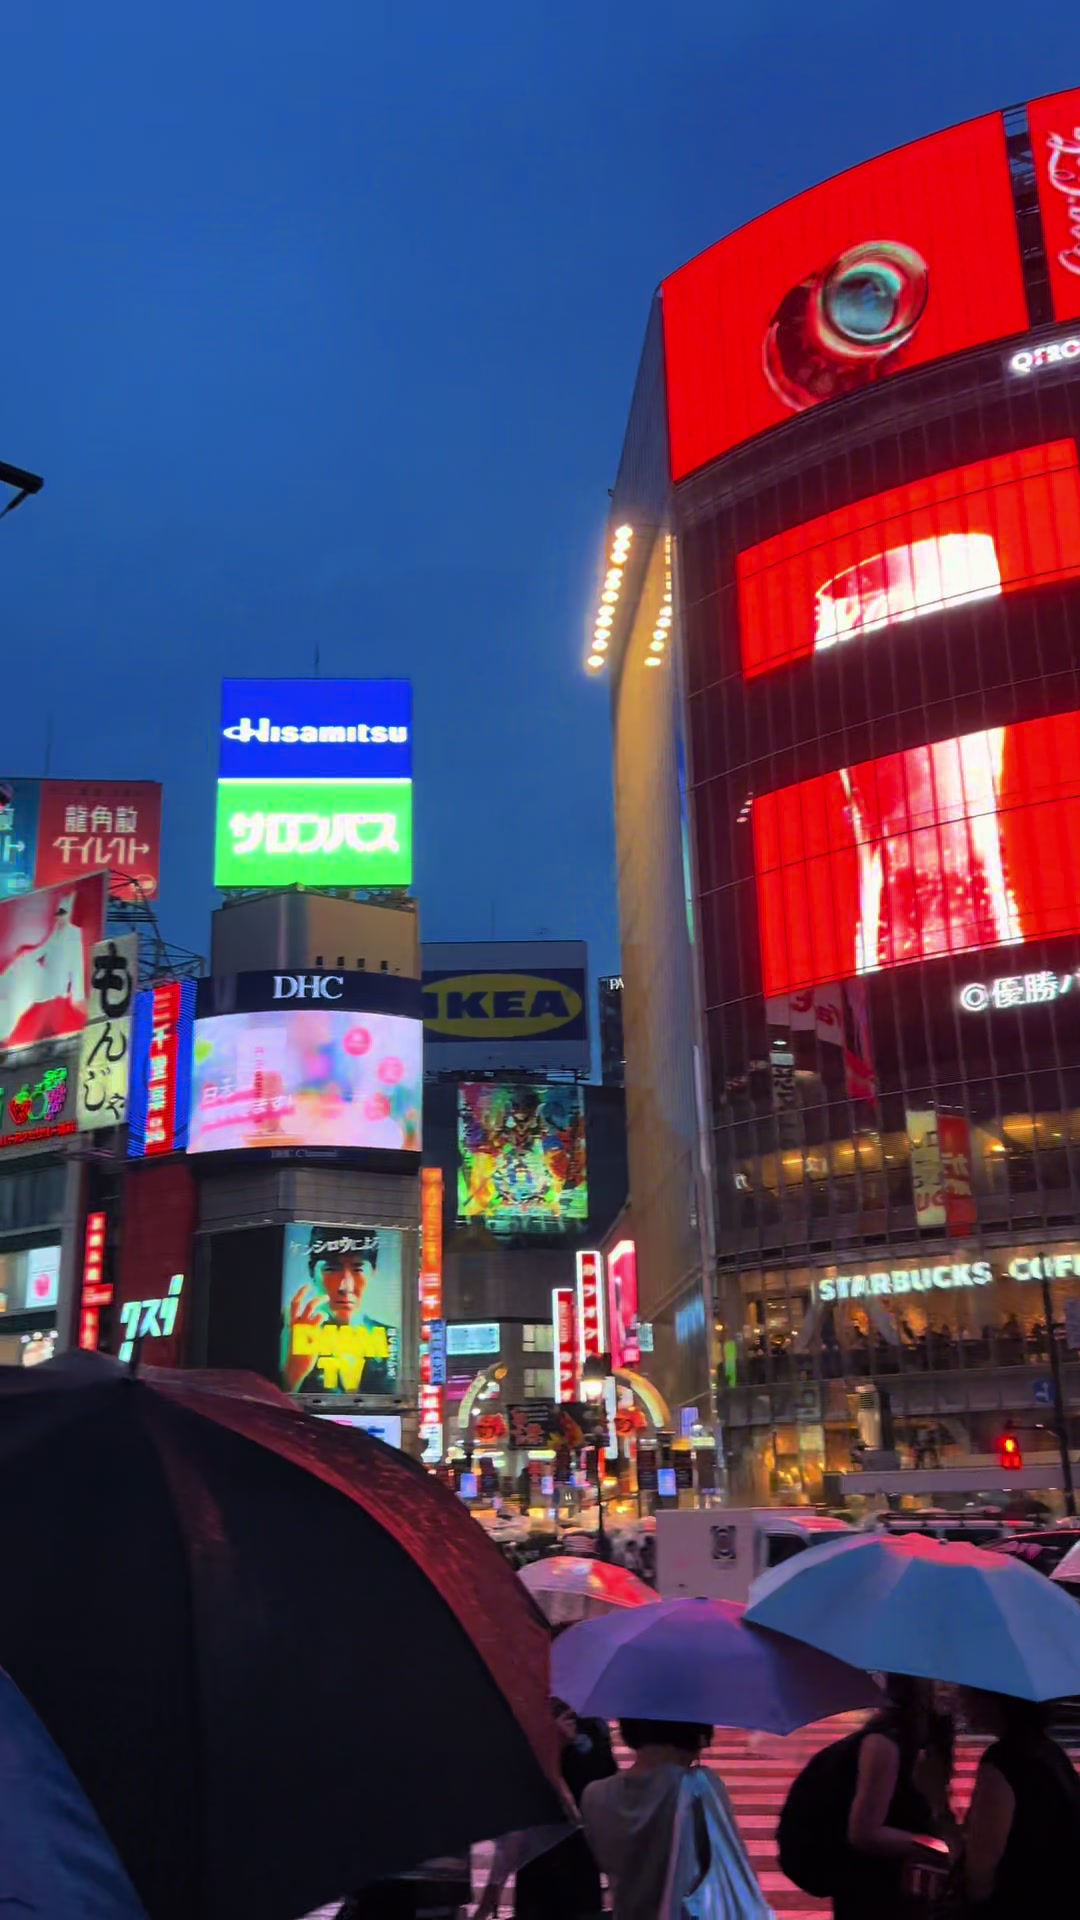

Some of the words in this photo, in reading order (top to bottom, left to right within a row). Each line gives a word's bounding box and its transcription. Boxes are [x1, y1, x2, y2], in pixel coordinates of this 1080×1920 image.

[223, 718, 408, 743] Hisamitsu
[229, 812, 400, 855] サロンパス
[53, 836, 150, 865] ダイレクト
[272, 975, 344, 999] DHC
[421, 990, 570, 1019] IKEA
[83, 941, 133, 1121] もんじゃ
[819, 1261, 993, 1301] STARBUCKS
[317, 1356, 366, 1390] TV
